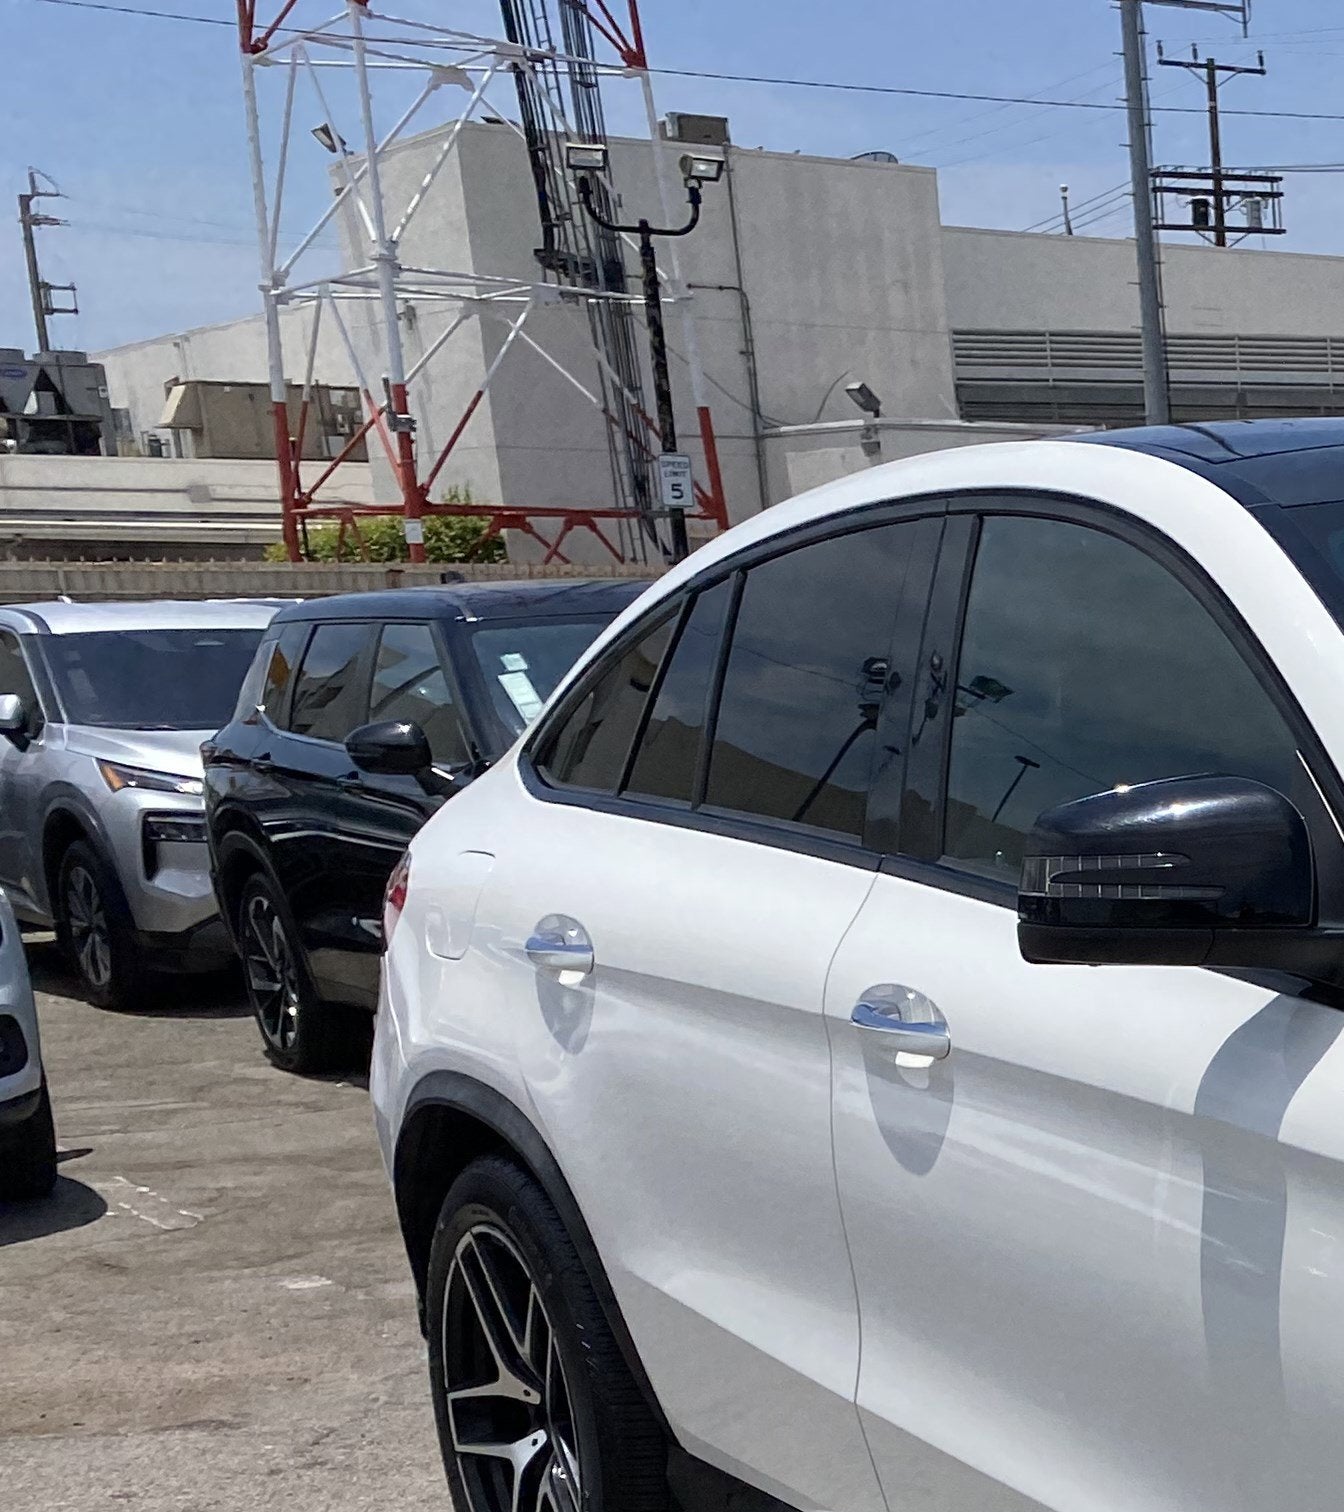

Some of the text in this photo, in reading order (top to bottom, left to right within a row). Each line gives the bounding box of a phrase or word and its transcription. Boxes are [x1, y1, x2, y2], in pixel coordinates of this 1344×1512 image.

[660, 461, 689, 469] SPEED
[664, 470, 687, 478] LIMIT
[671, 483, 684, 499] 5
